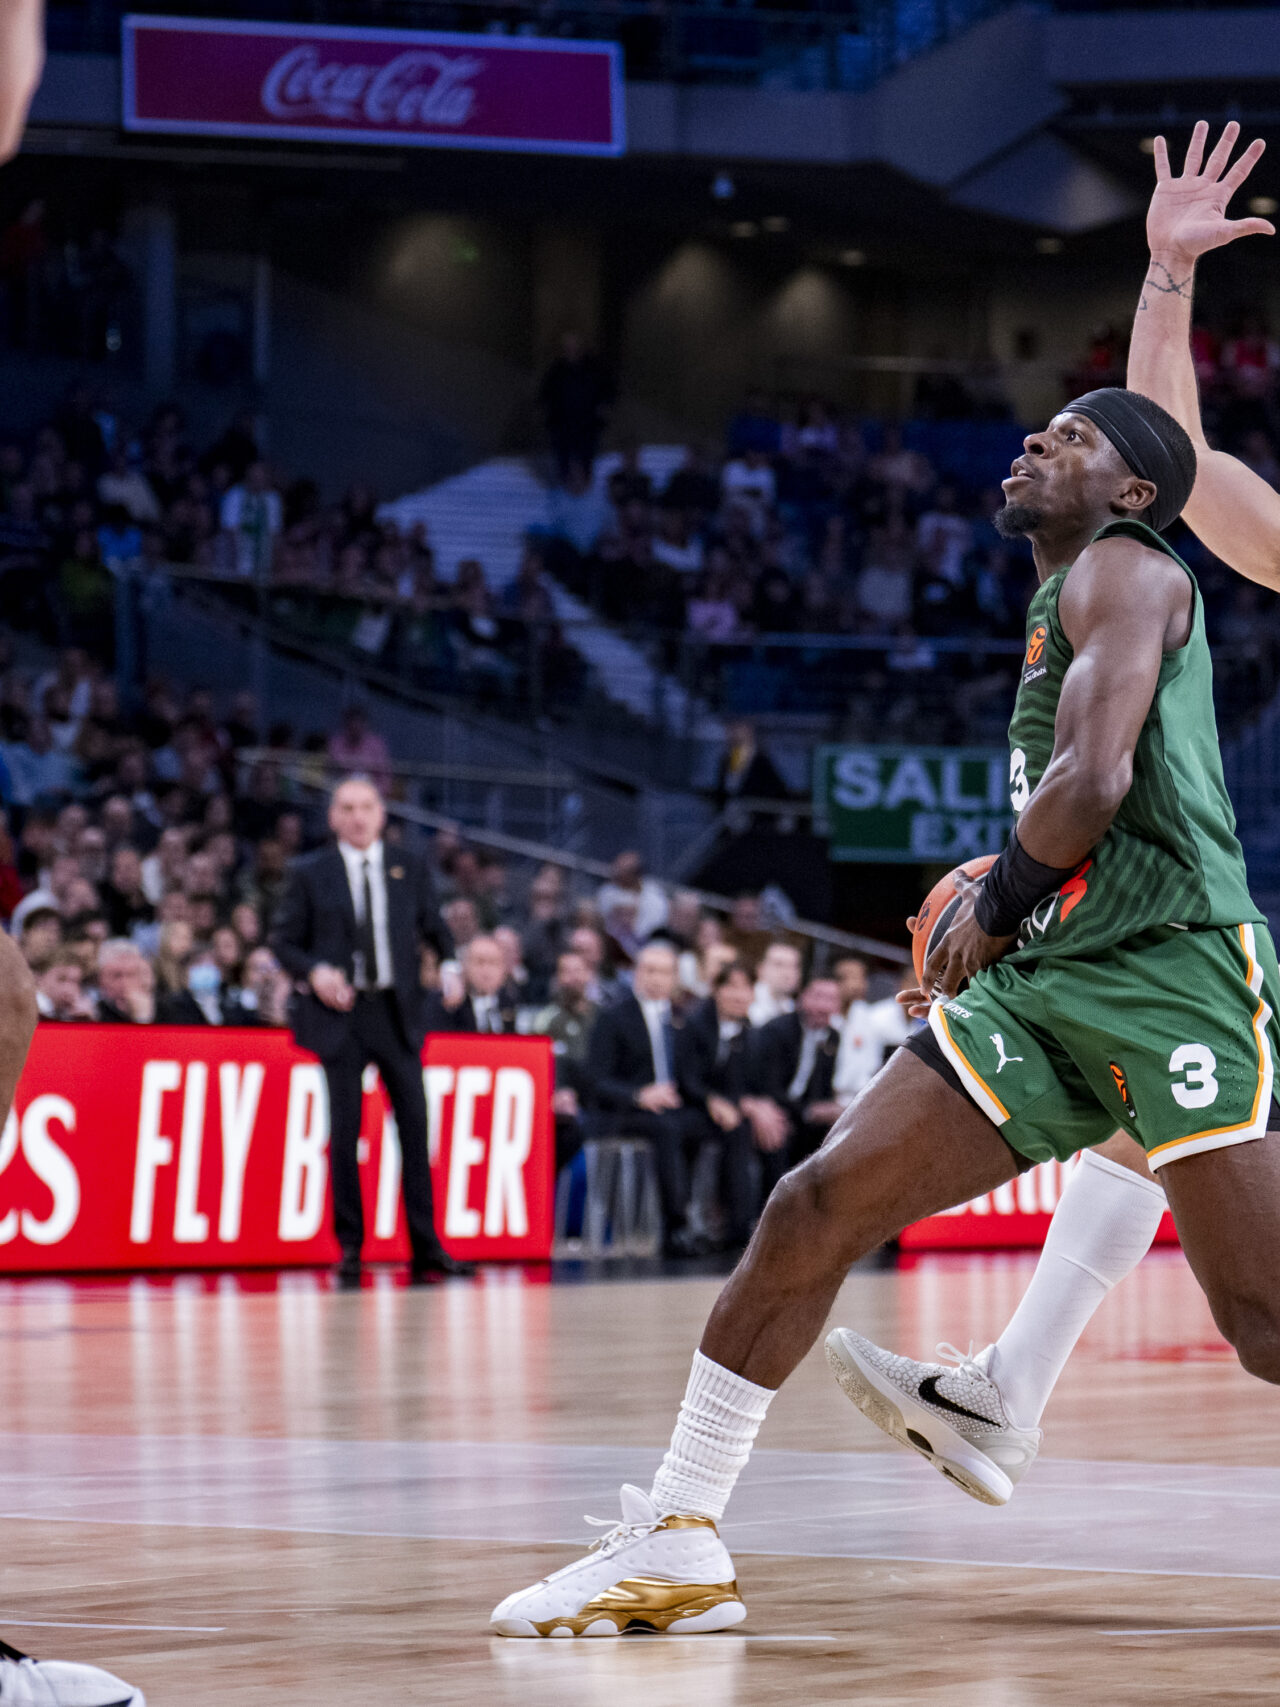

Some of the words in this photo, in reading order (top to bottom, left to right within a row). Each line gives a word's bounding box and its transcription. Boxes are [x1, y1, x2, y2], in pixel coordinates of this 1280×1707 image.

[910, 814, 1008, 858] EXI
[1169, 1043, 1219, 1109] 3
[130, 1060, 265, 1244] FLY
